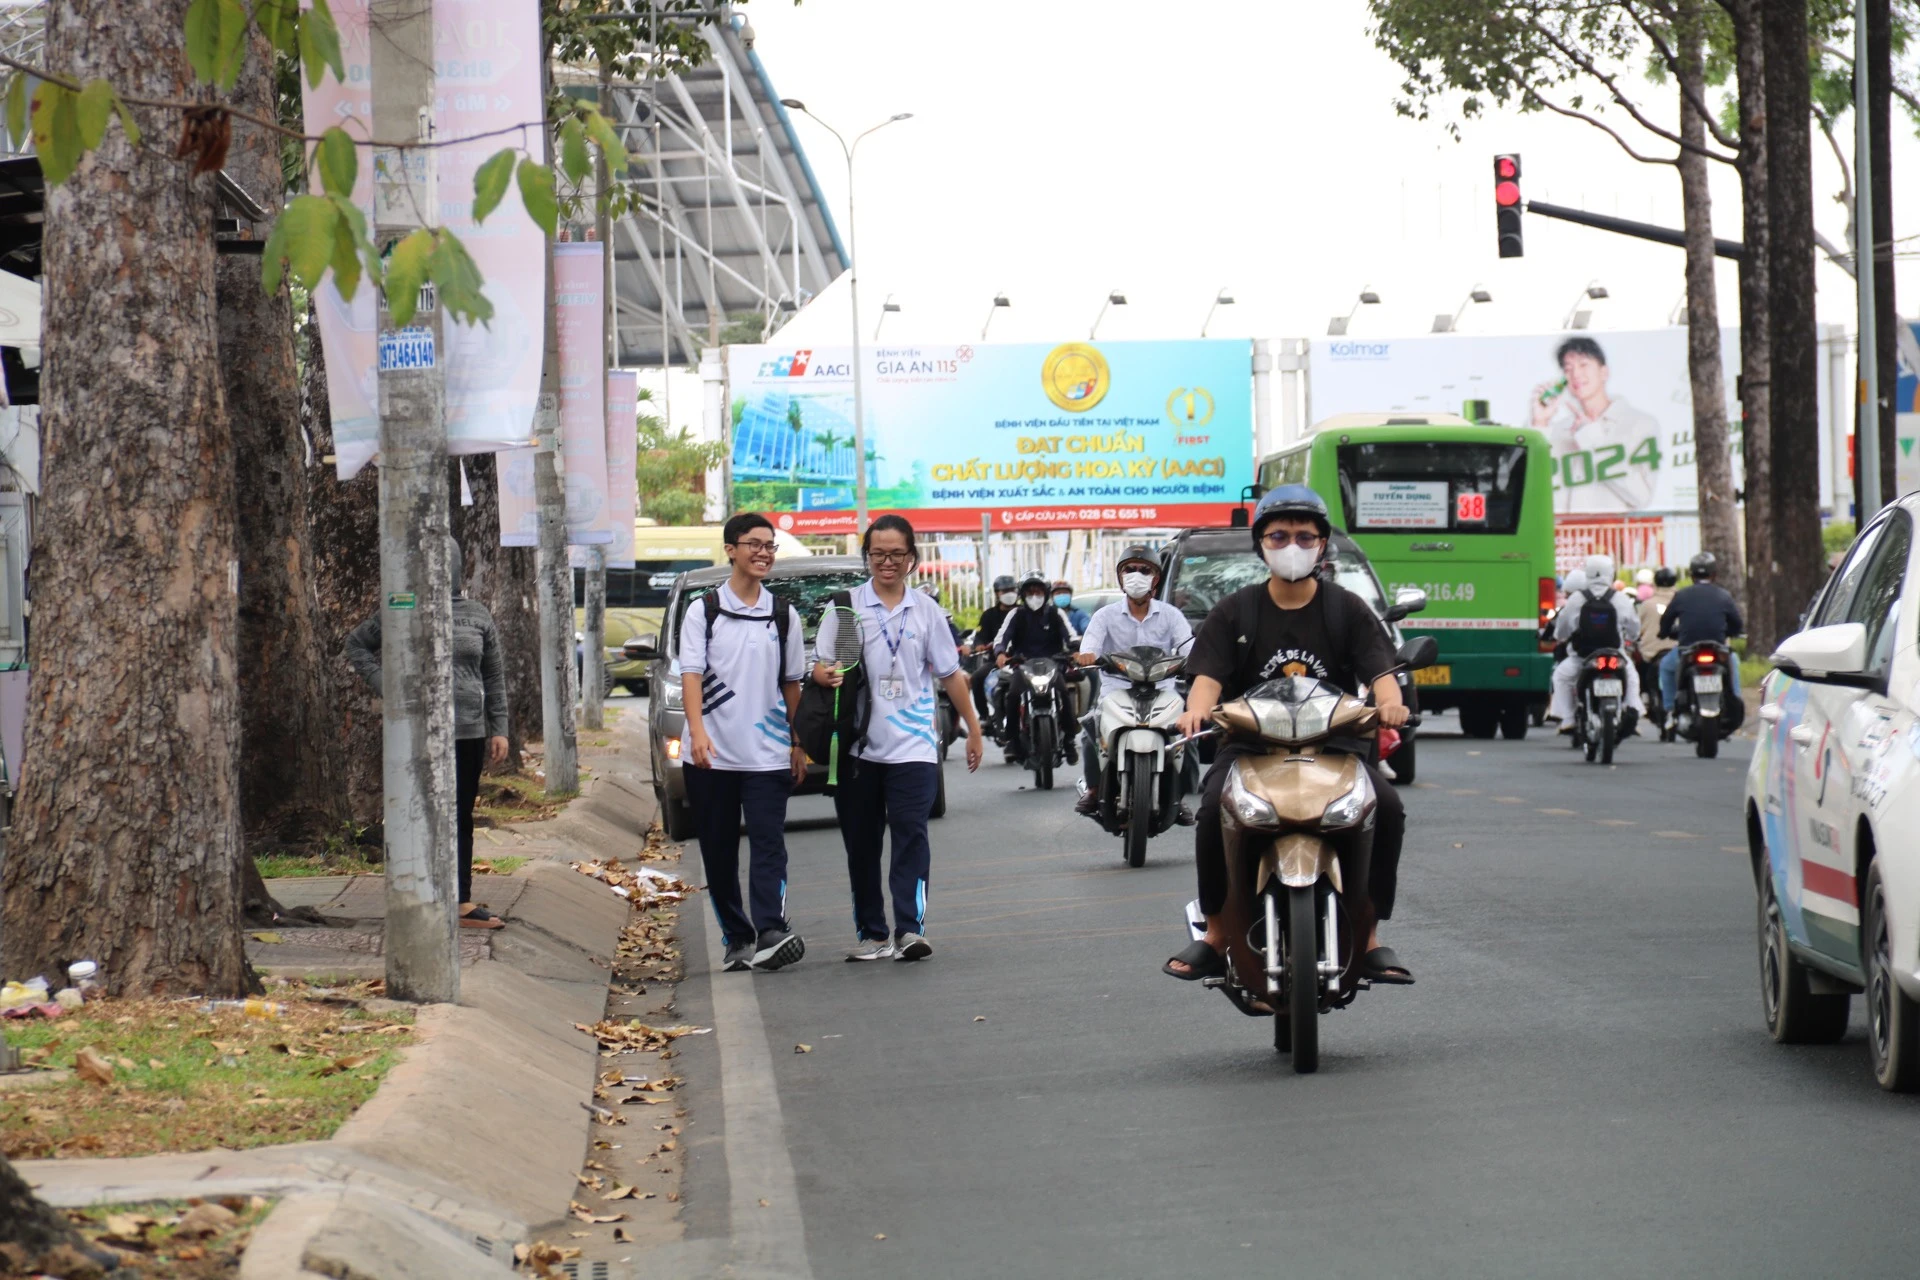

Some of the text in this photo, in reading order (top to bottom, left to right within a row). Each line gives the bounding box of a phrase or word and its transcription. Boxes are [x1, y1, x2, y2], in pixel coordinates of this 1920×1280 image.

[814, 363, 851, 377] AACI
[876, 359, 958, 374] GIA AN 115
[994, 418, 1022, 430] BỆNH
[1024, 417, 1047, 430] VIỆN
[1114, 416, 1136, 428] VIỆT
[1137, 417, 1160, 427] NAM
[1016, 429, 1144, 458] ĐẠT CHUẨN
[1177, 435, 1211, 446] FIRST
[931, 457, 991, 482] CHẤT
[994, 459, 1072, 483] LƯỢNG
[1075, 459, 1125, 480] HOA
[1161, 456, 1226, 480] (AACI)
[932, 488, 965, 501] BỆNH
[967, 487, 995, 500] VIỆN
[997, 485, 1029, 499] XUẤT
[1032, 484, 1056, 497] SẮC
[1068, 487, 1085, 496] AN
[1089, 485, 1121, 497] TOÀN
[1124, 486, 1149, 496] CHO
[1152, 484, 1190, 495] NGƯỜI
[1193, 482, 1225, 496] BỆNH
[1015, 509, 1035, 521] CẤP
[1036, 509, 1056, 521] CỨU
[1079, 508, 1100, 520] 028
[1103, 508, 1117, 520] 62
[1118, 508, 1139, 519] 655
[1140, 508, 1157, 519] 115
[1458, 493, 1486, 520] 38
[1259, 648, 1328, 679] ACMÉ DE LA VIE
